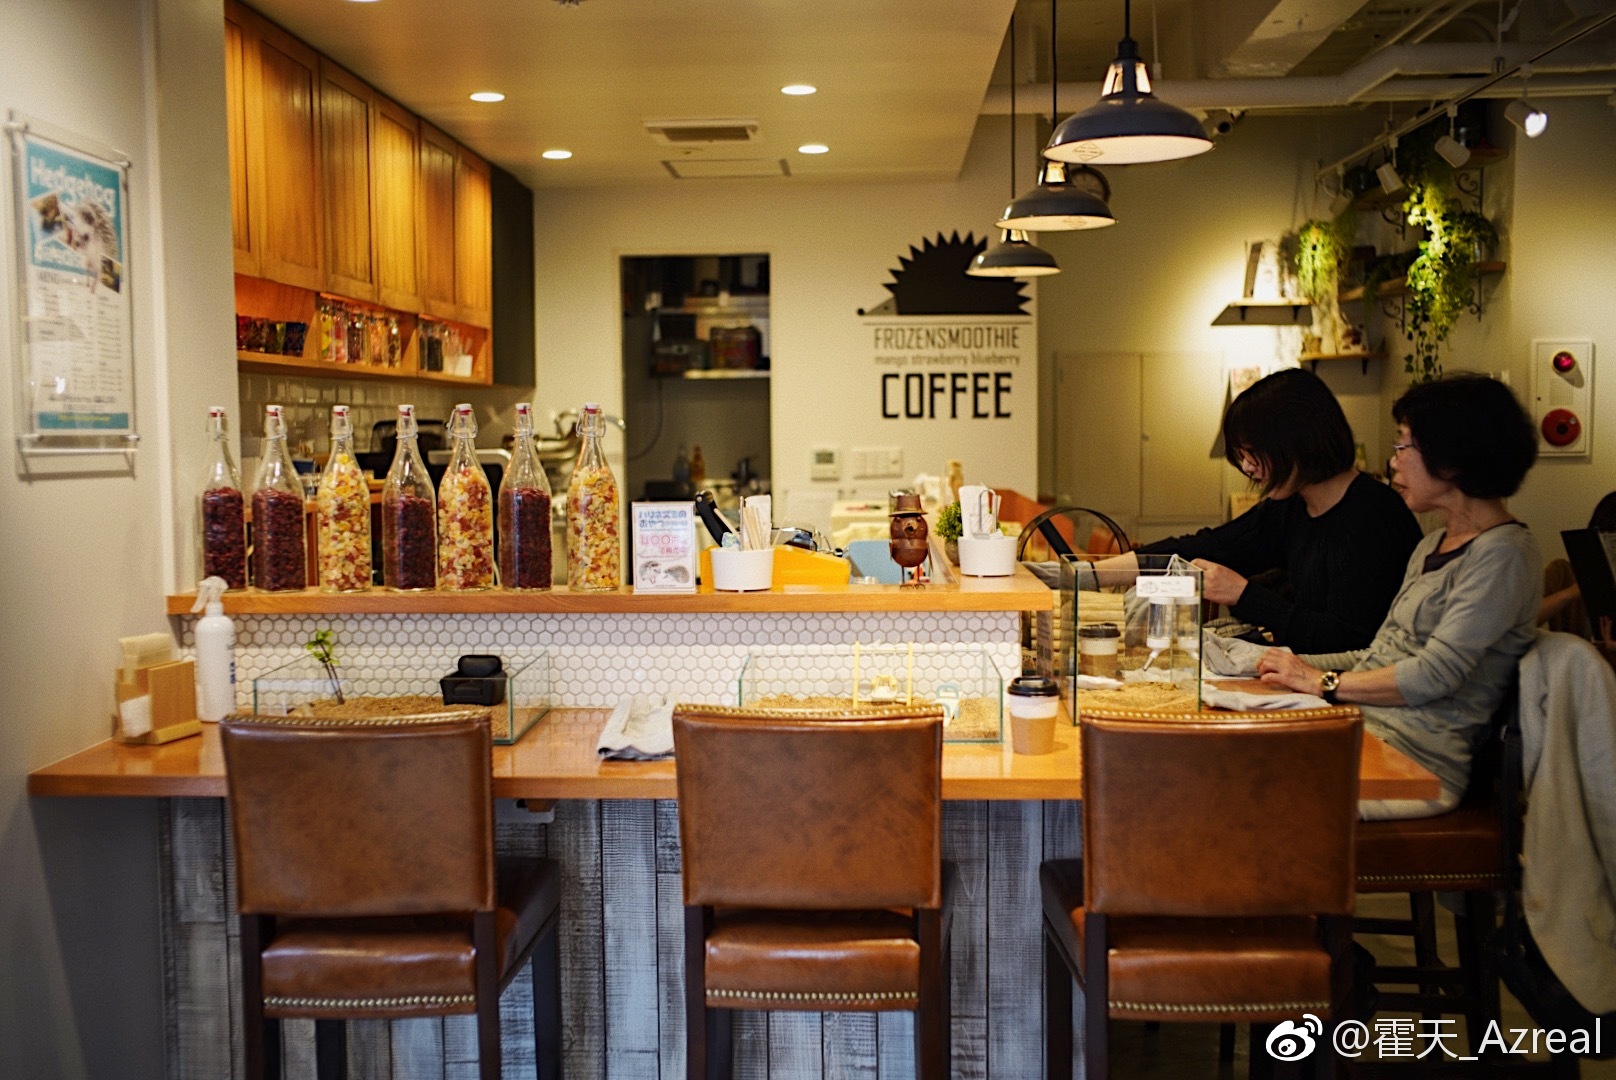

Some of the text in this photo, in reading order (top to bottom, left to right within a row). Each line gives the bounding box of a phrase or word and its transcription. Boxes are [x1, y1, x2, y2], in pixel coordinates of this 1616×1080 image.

[874, 327, 1020, 349] FROZENSMOOTHIE
[912, 353, 968, 366] strawberry
[971, 352, 1020, 366] blueberry
[882, 372, 1012, 419] COFFEE
[639, 510, 687, 519] ハリネズミの
